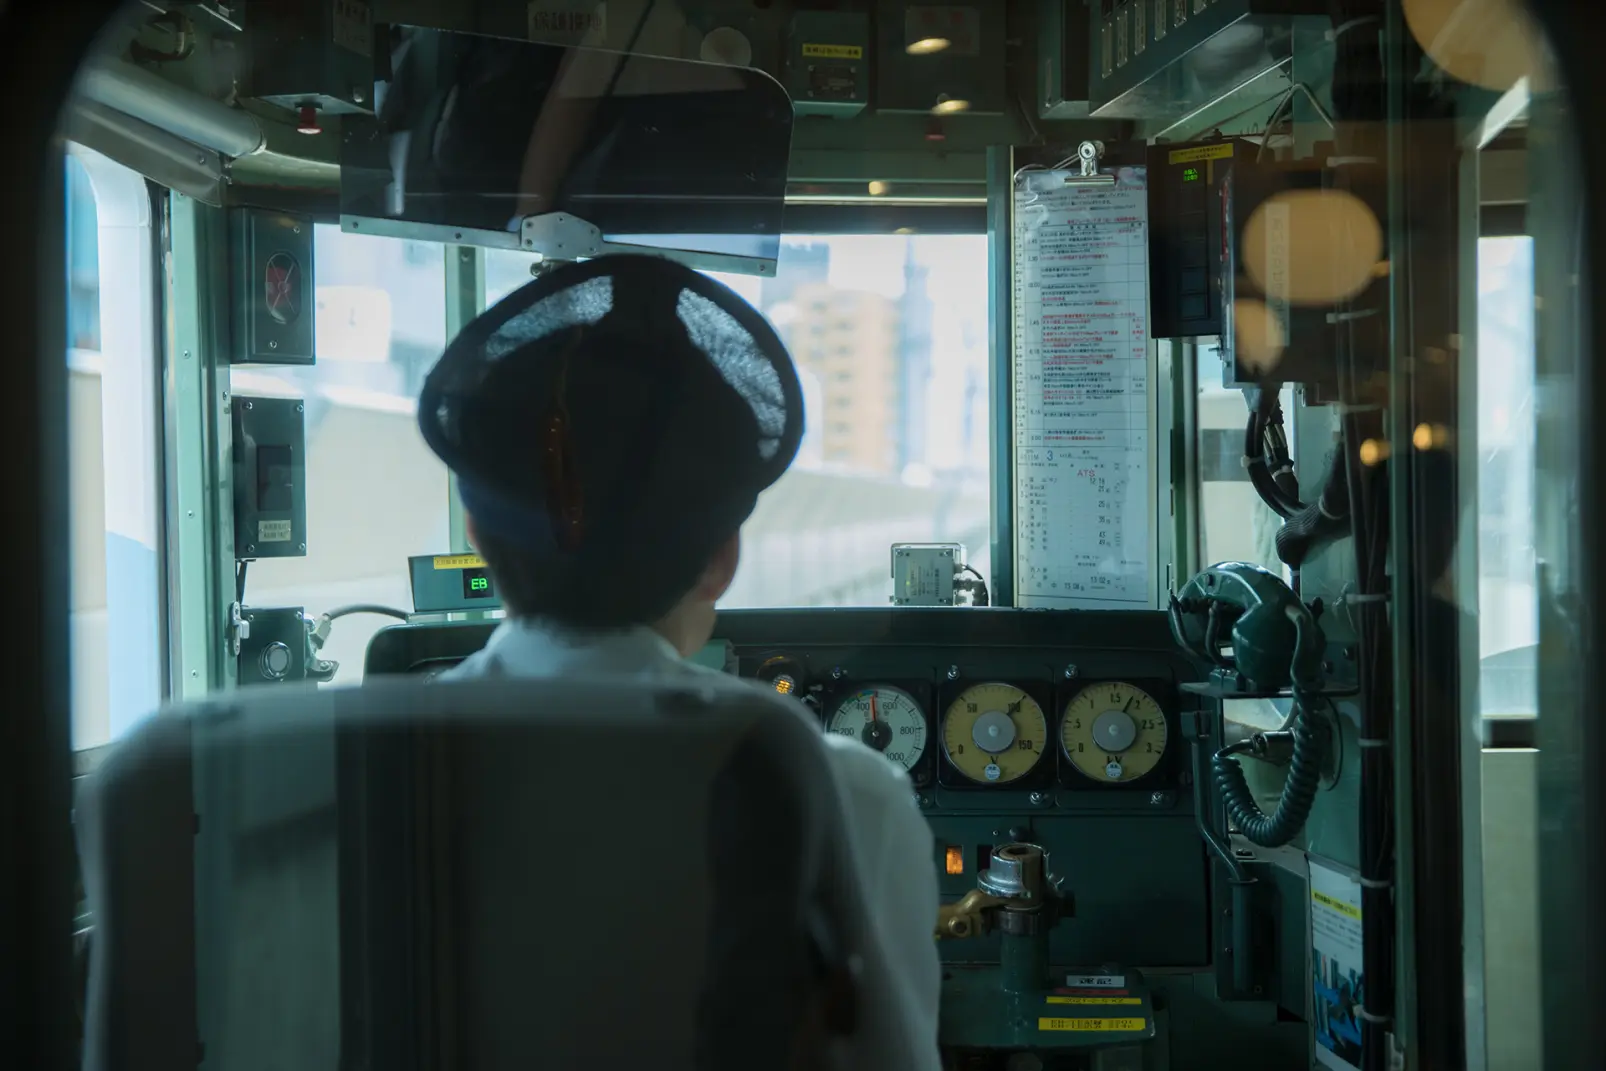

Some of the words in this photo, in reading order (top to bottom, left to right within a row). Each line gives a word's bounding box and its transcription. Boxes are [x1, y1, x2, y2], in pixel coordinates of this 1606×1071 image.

[1046, 450, 1054, 462] 3
[1077, 469, 1096, 478] ATS
[471, 578, 488, 590] EB
[967, 703, 977, 713] 50
[1090, 700, 1094, 709] 1
[1134, 700, 1140, 709] 2
[958, 744, 964, 754] 0
[1018, 740, 1033, 750] 150
[1078, 743, 1083, 753] 0
[1146, 742, 1152, 753] 3
[886, 753, 904, 761] 1000
